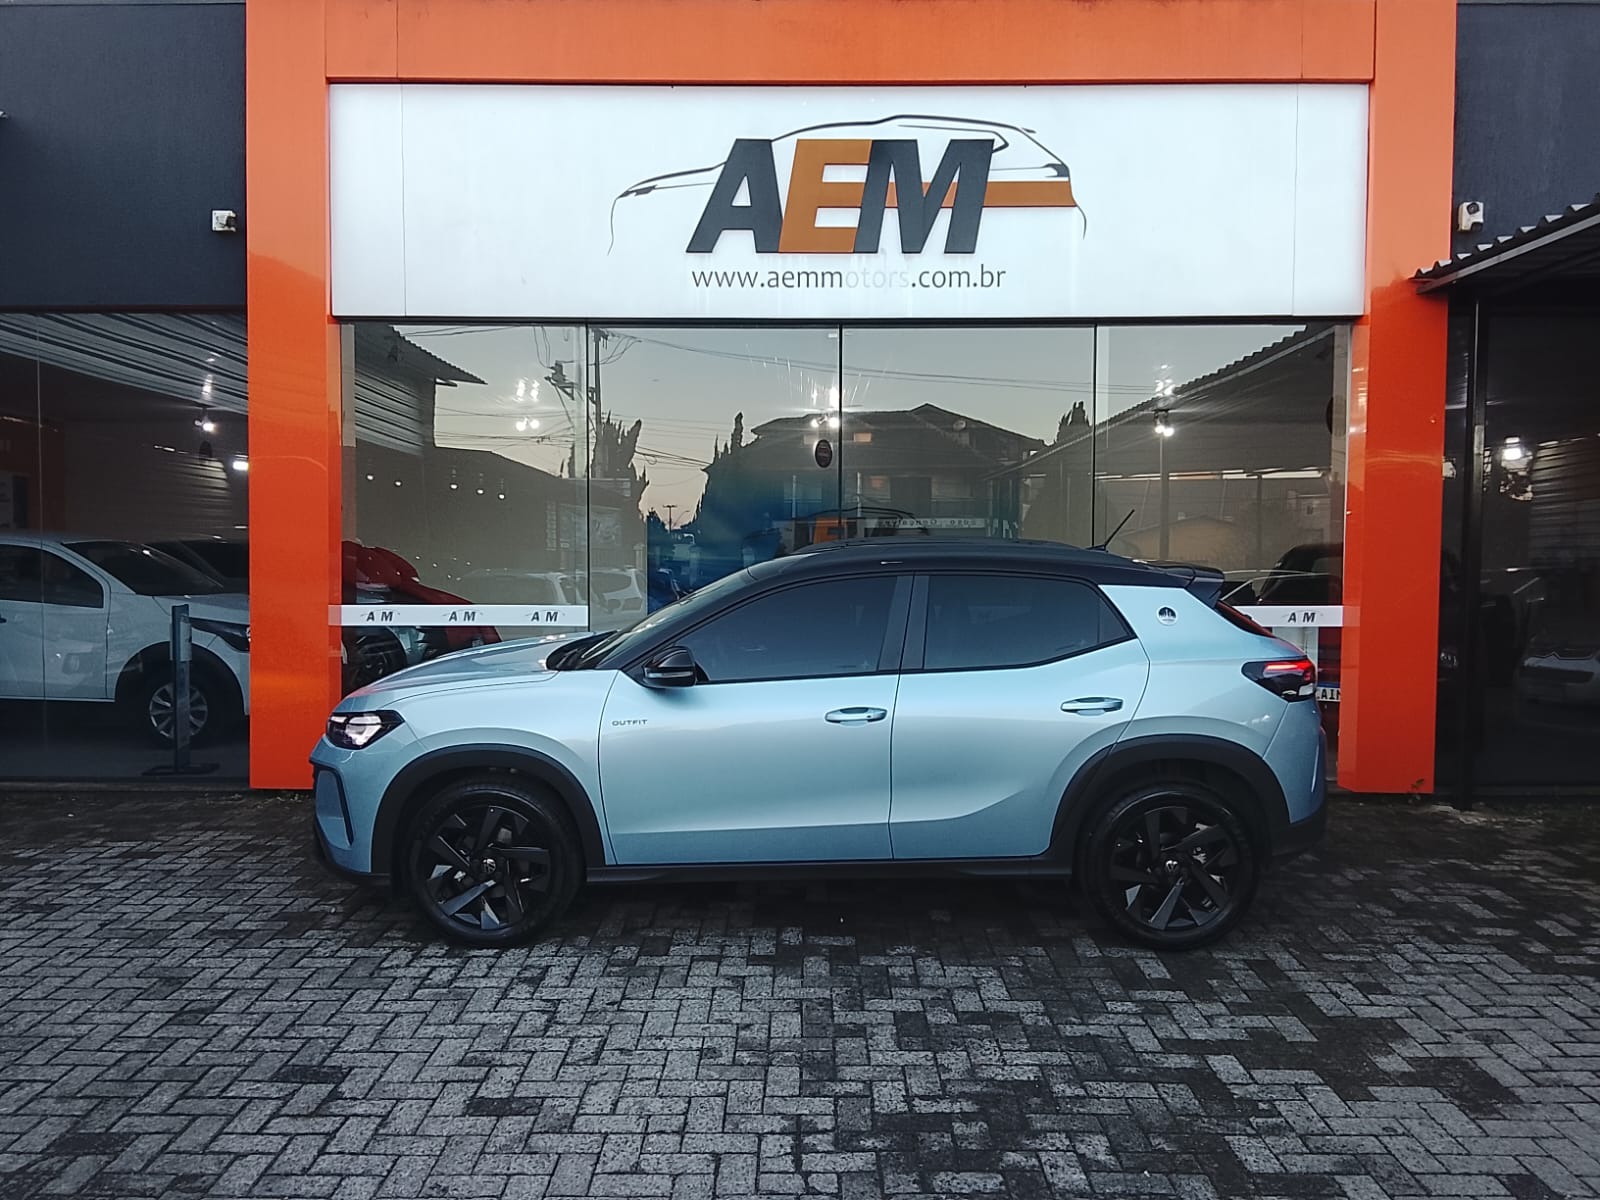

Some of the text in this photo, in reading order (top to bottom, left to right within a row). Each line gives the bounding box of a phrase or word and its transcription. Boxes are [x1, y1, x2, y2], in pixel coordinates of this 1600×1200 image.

[686, 138, 996, 255] AEM
[691, 264, 1006, 289] www.aemmotors.com.br
[611, 718, 648, 727] OUTFIT
